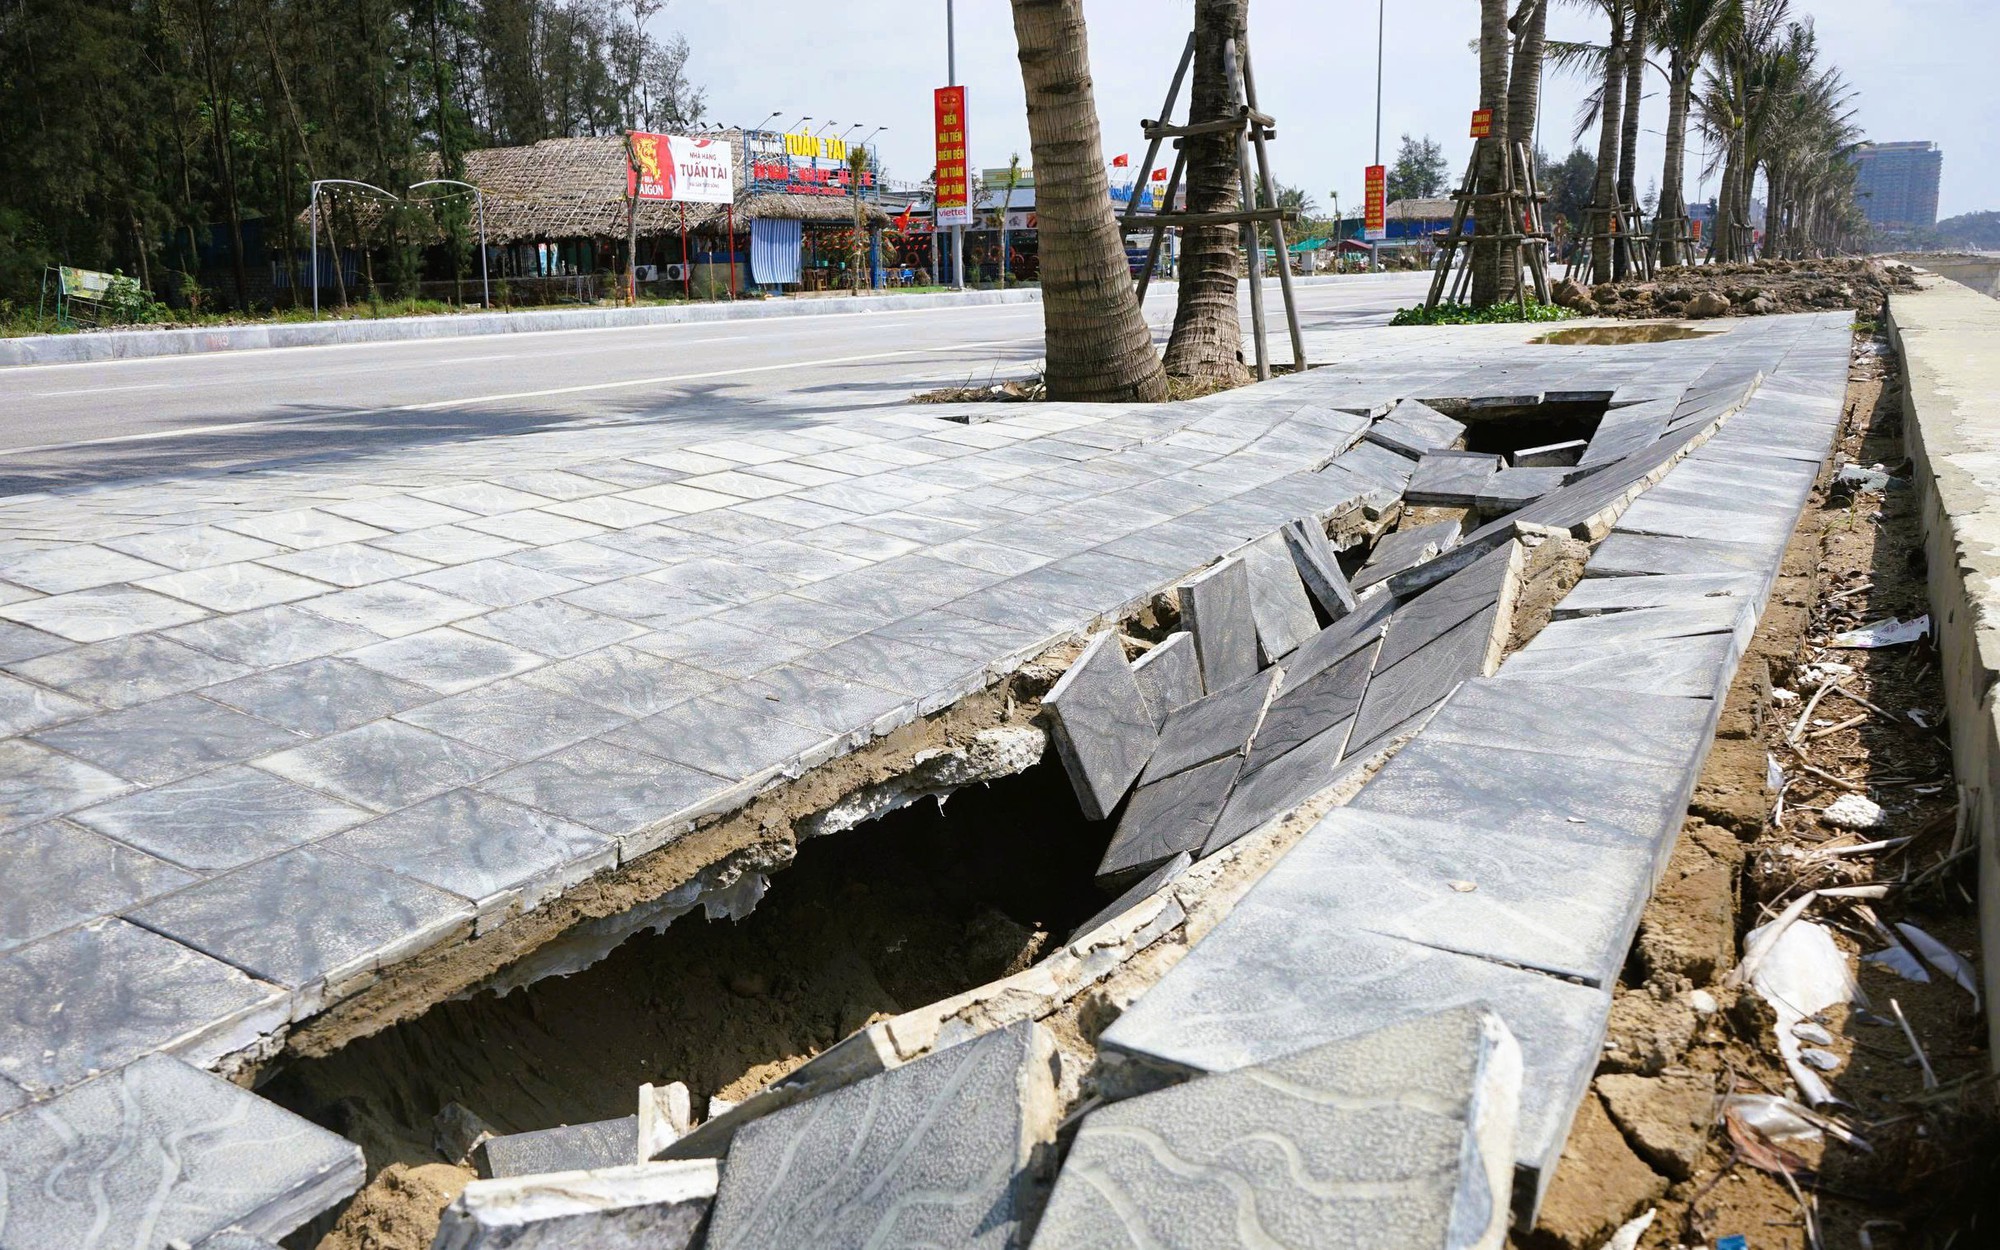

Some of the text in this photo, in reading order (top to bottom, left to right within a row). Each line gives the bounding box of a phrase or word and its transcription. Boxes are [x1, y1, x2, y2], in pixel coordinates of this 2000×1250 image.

[784, 127, 821, 157] TUẤN
[825, 134, 846, 160] TÀI
[680, 161, 728, 180] TUẤN TÀI
[637, 183, 664, 196] AIGON
[938, 208, 967, 217] viettel
